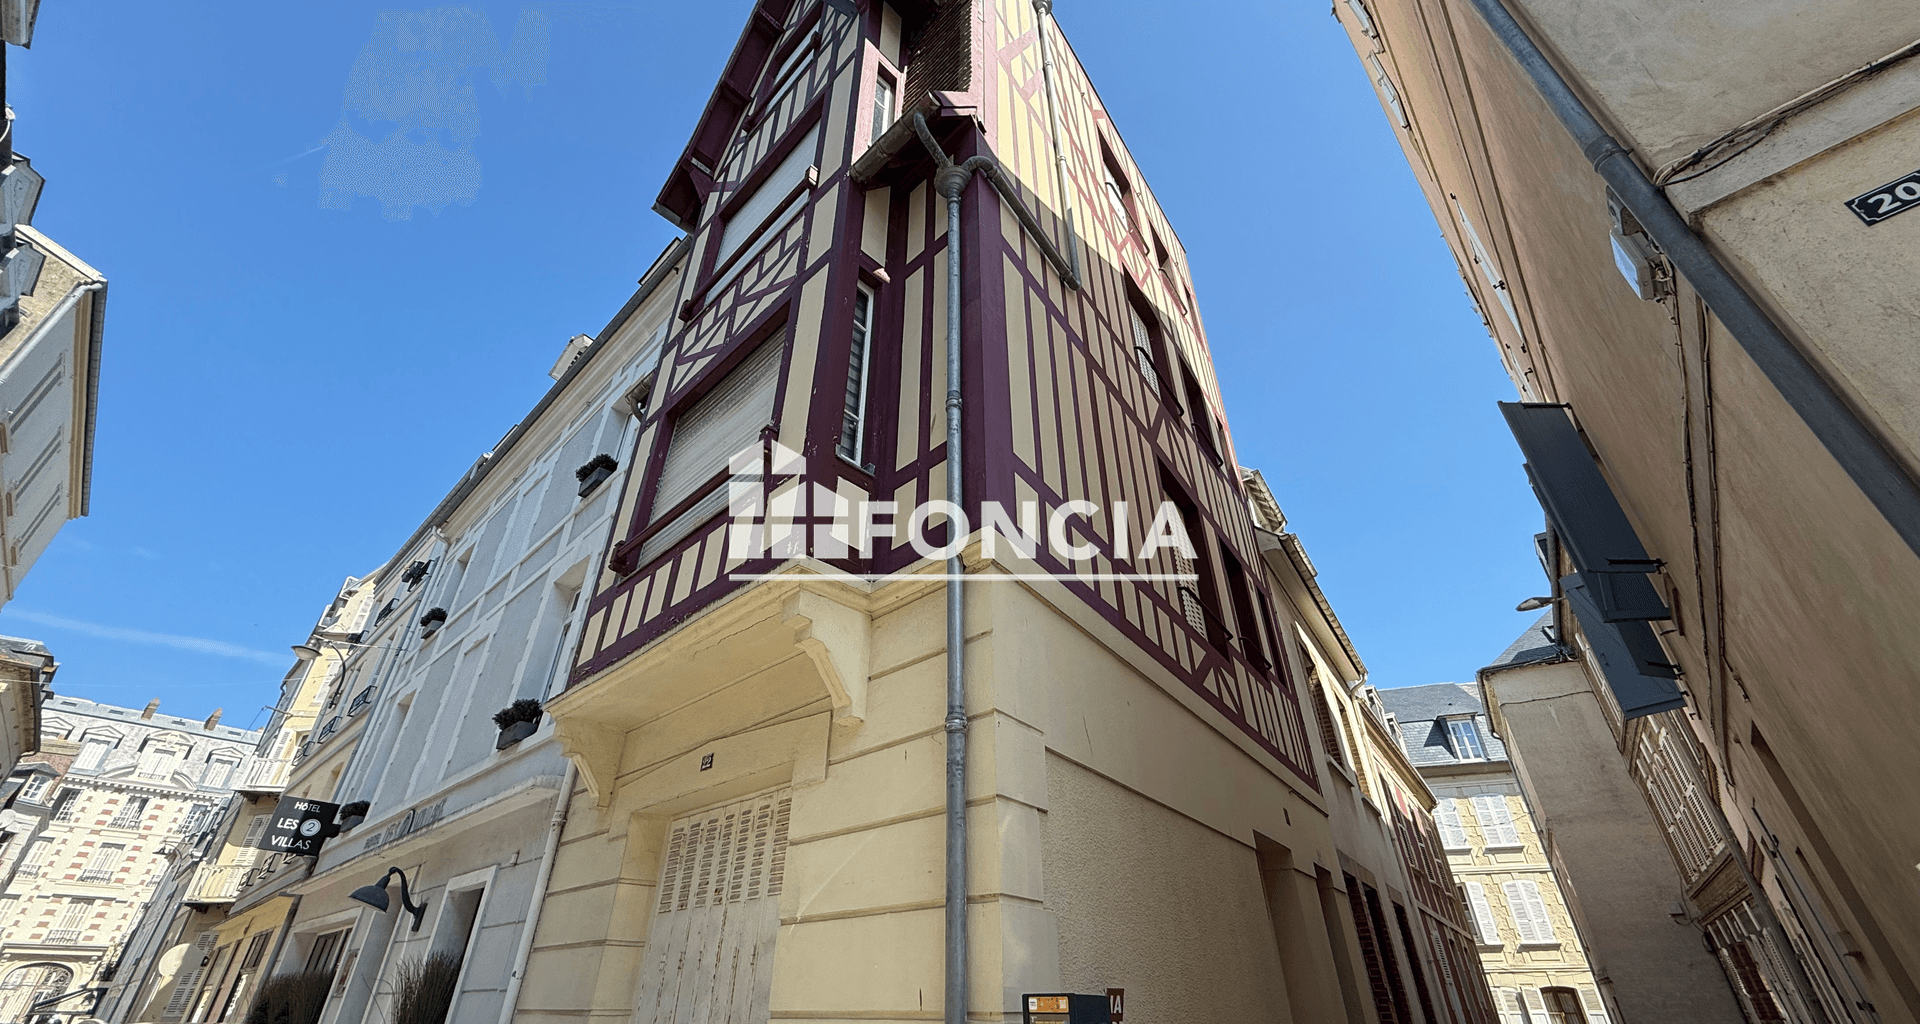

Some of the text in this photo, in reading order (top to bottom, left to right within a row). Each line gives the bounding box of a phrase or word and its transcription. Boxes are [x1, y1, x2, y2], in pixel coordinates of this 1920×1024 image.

[1867, 181, 1920, 213] 20
[277, 818, 299, 830] LES
[271, 835, 311, 850] VILLAS
